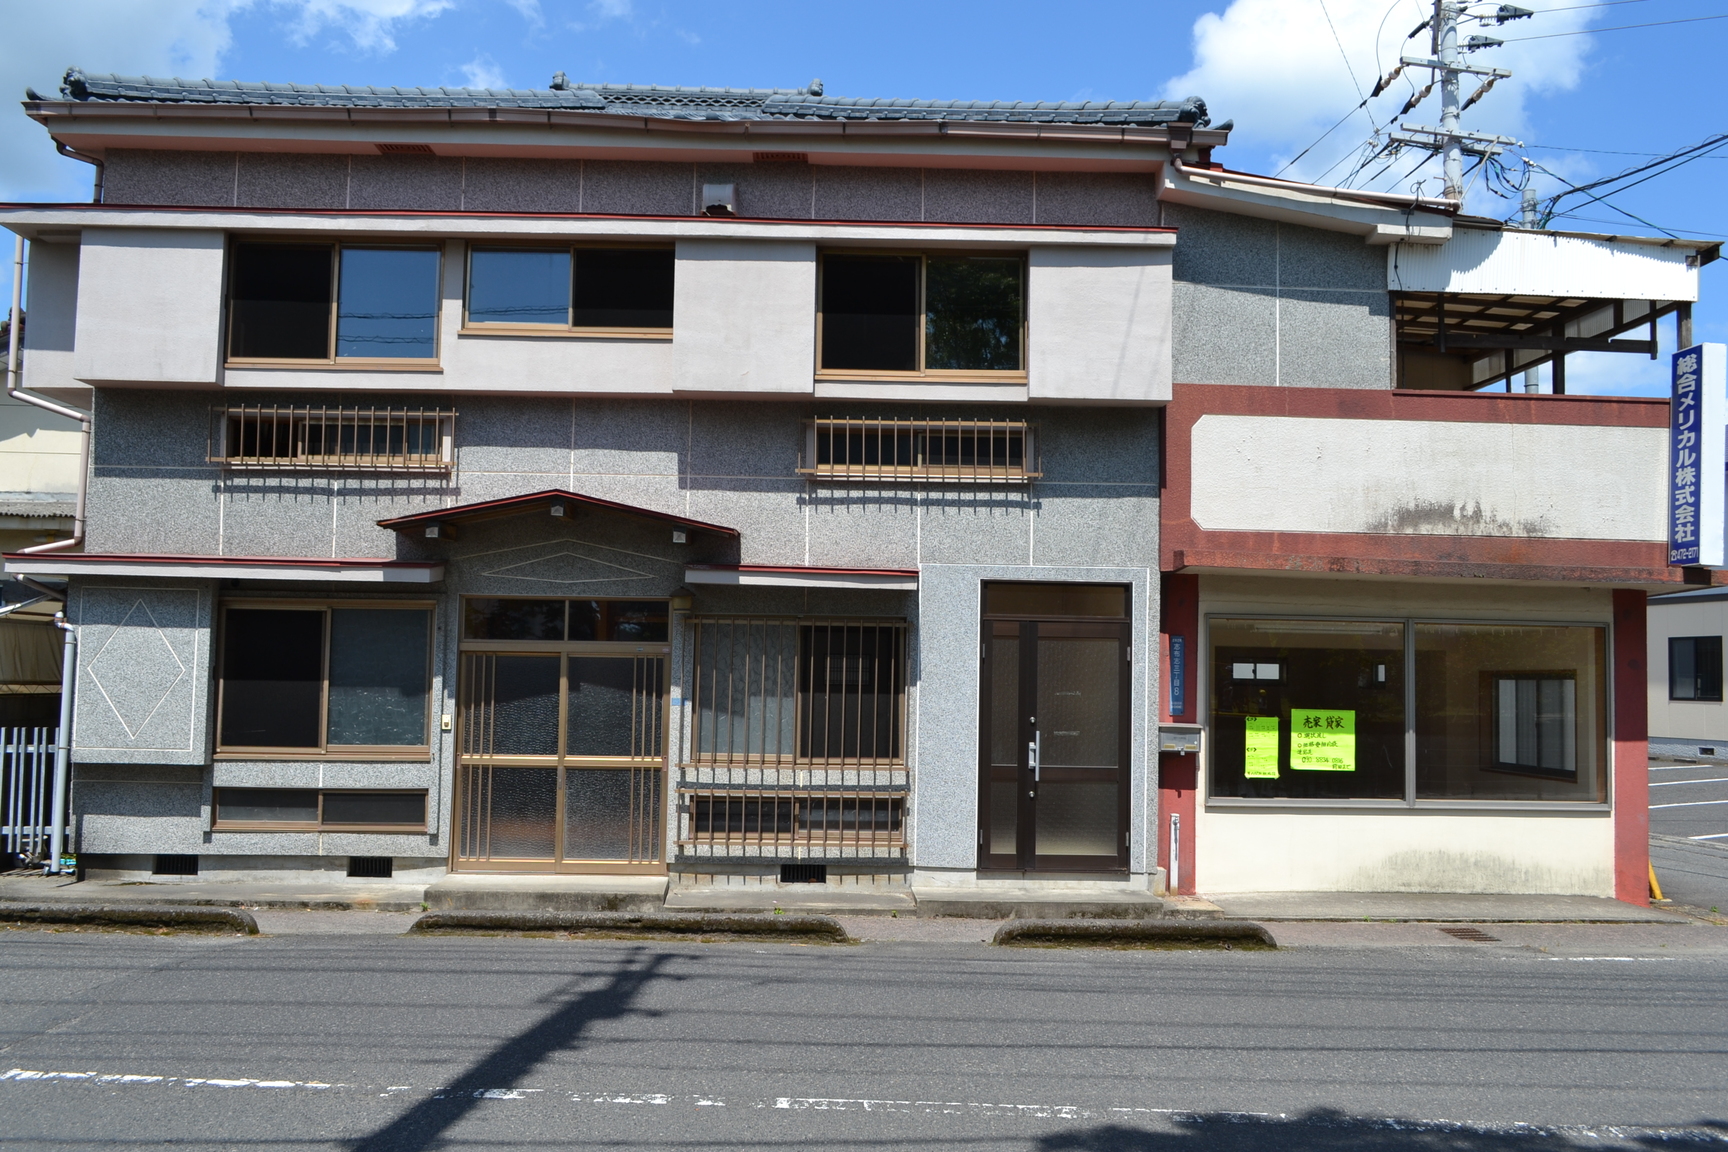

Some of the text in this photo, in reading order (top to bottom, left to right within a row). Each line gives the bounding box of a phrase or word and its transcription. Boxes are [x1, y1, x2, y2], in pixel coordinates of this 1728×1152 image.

[1675, 353, 1698, 543] 総合メリカル株式会社
[1303, 715, 1345, 730] 売家 貸家
